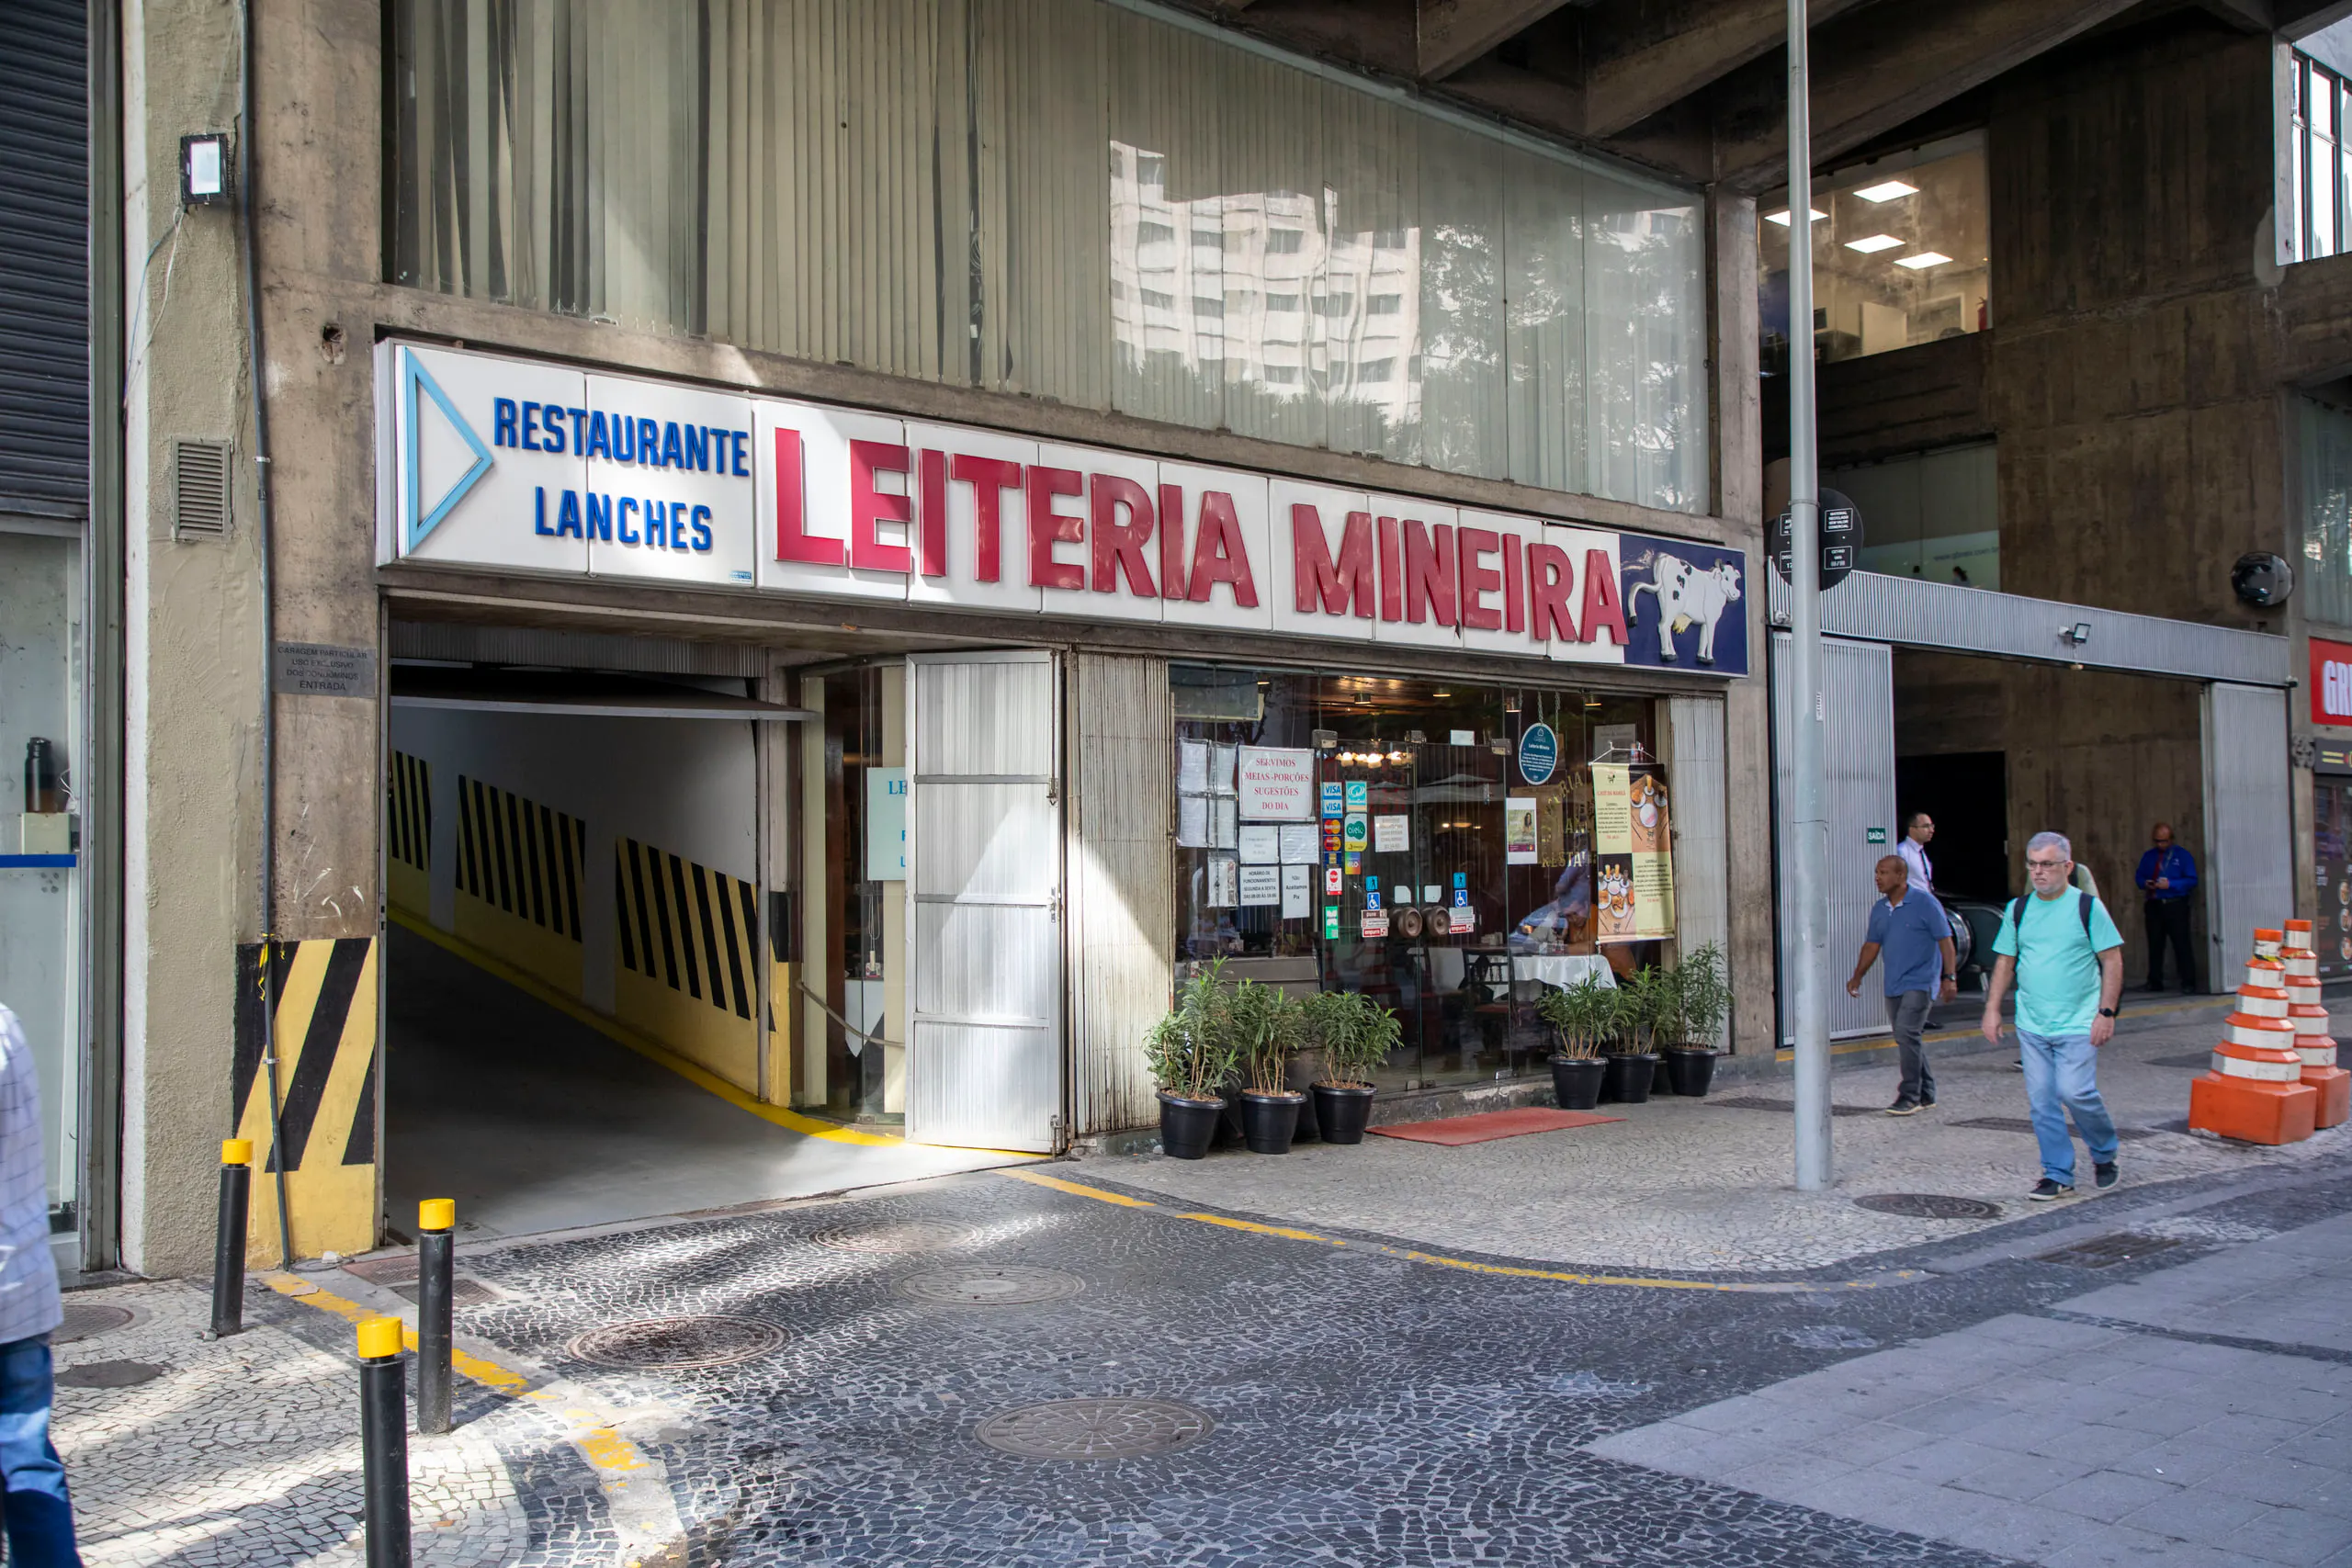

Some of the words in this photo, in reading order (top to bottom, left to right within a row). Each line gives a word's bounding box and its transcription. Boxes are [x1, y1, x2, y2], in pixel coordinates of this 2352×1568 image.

[493, 397, 749, 478] RESTAURANTE
[535, 486, 713, 551] LANCHES
[774, 427, 1260, 608] LEITERIA
[1292, 502, 1630, 645] MINEIRA
[300, 680, 346, 691] ENTRADA
[1256, 757, 1296, 768] SERVIMOS
[1245, 772, 1270, 781] MEIAS
[1254, 785, 1299, 796] SUGESTÕES
[1326, 785, 1341, 794] VISA
[1261, 801, 1273, 810] DO
[1326, 802, 1341, 811] VISA
[1868, 830, 1884, 840] SAÍDA
